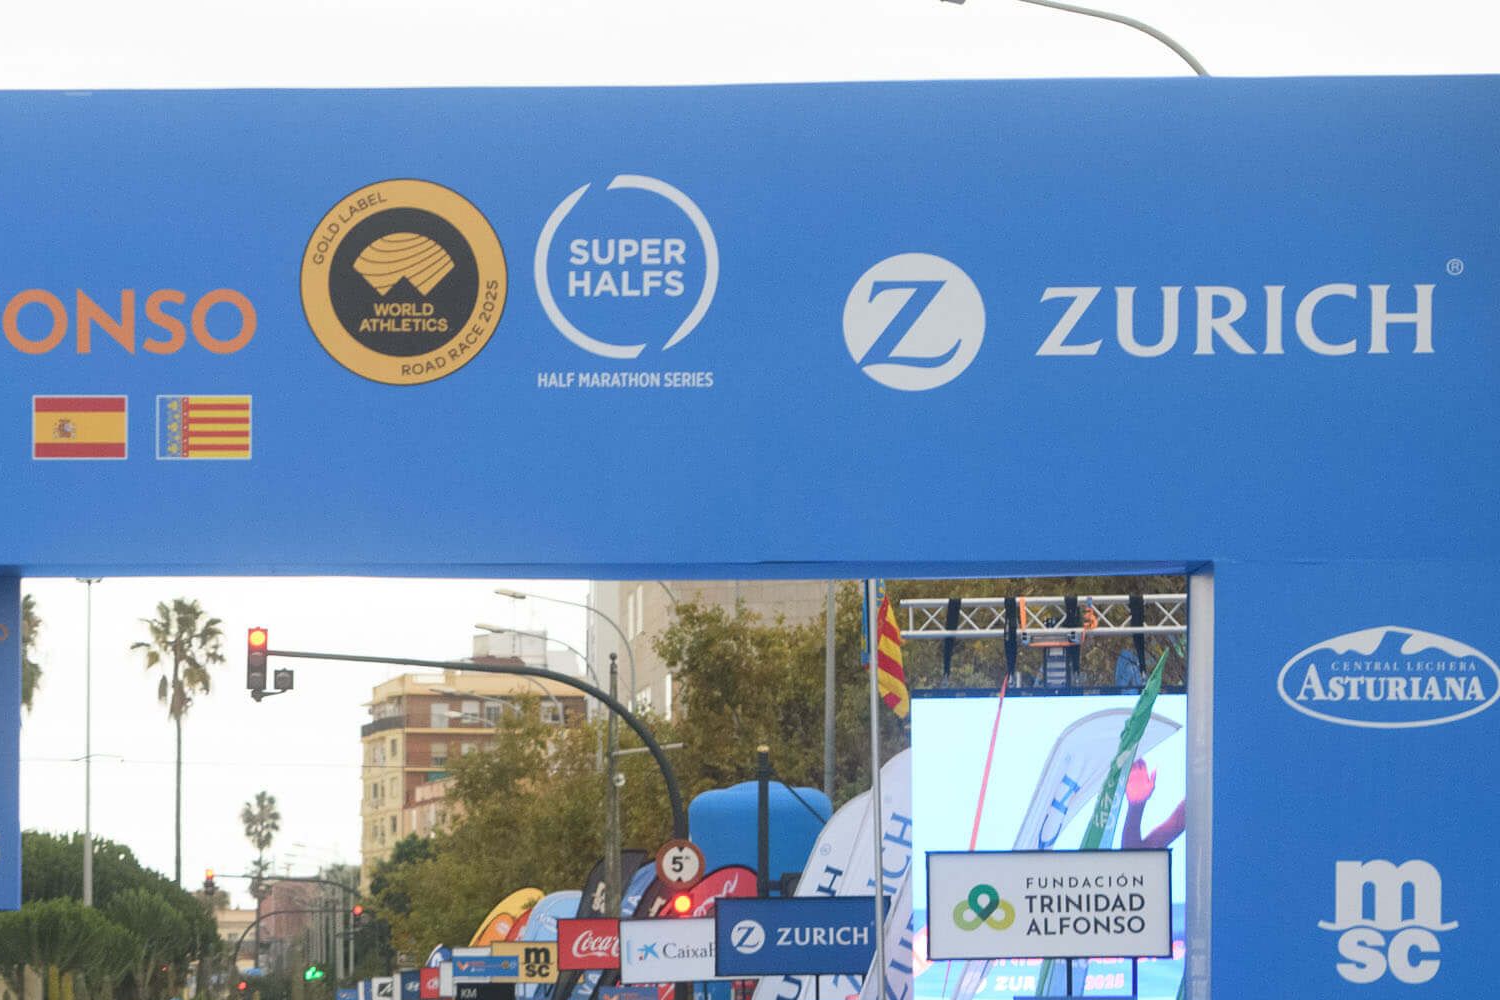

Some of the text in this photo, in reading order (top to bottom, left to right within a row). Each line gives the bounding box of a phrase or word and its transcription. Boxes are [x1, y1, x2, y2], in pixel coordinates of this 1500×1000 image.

[312, 191, 388, 265] GOLD LABEL
[569, 238, 686, 265] SUPER
[568, 269, 685, 297] HALFS
[375, 303, 434, 317] WORLD
[1035, 283, 1436, 358] ZURICH
[359, 318, 448, 333] ATHLETICS
[401, 279, 499, 378] ROAD RACE 2025
[538, 372, 714, 388] HALF MARATHON SERIES
[1331, 661, 1478, 672] CENTRAL LECHERA
[1296, 664, 1486, 702] ASTURIANA
[671, 856, 684, 873] 5
[1026, 873, 1145, 889] FUNDACIÓN
[1025, 892, 1146, 914] TRINIDAD
[776, 926, 868, 946] ZURICH
[1026, 915, 1147, 937] ALFONSO
